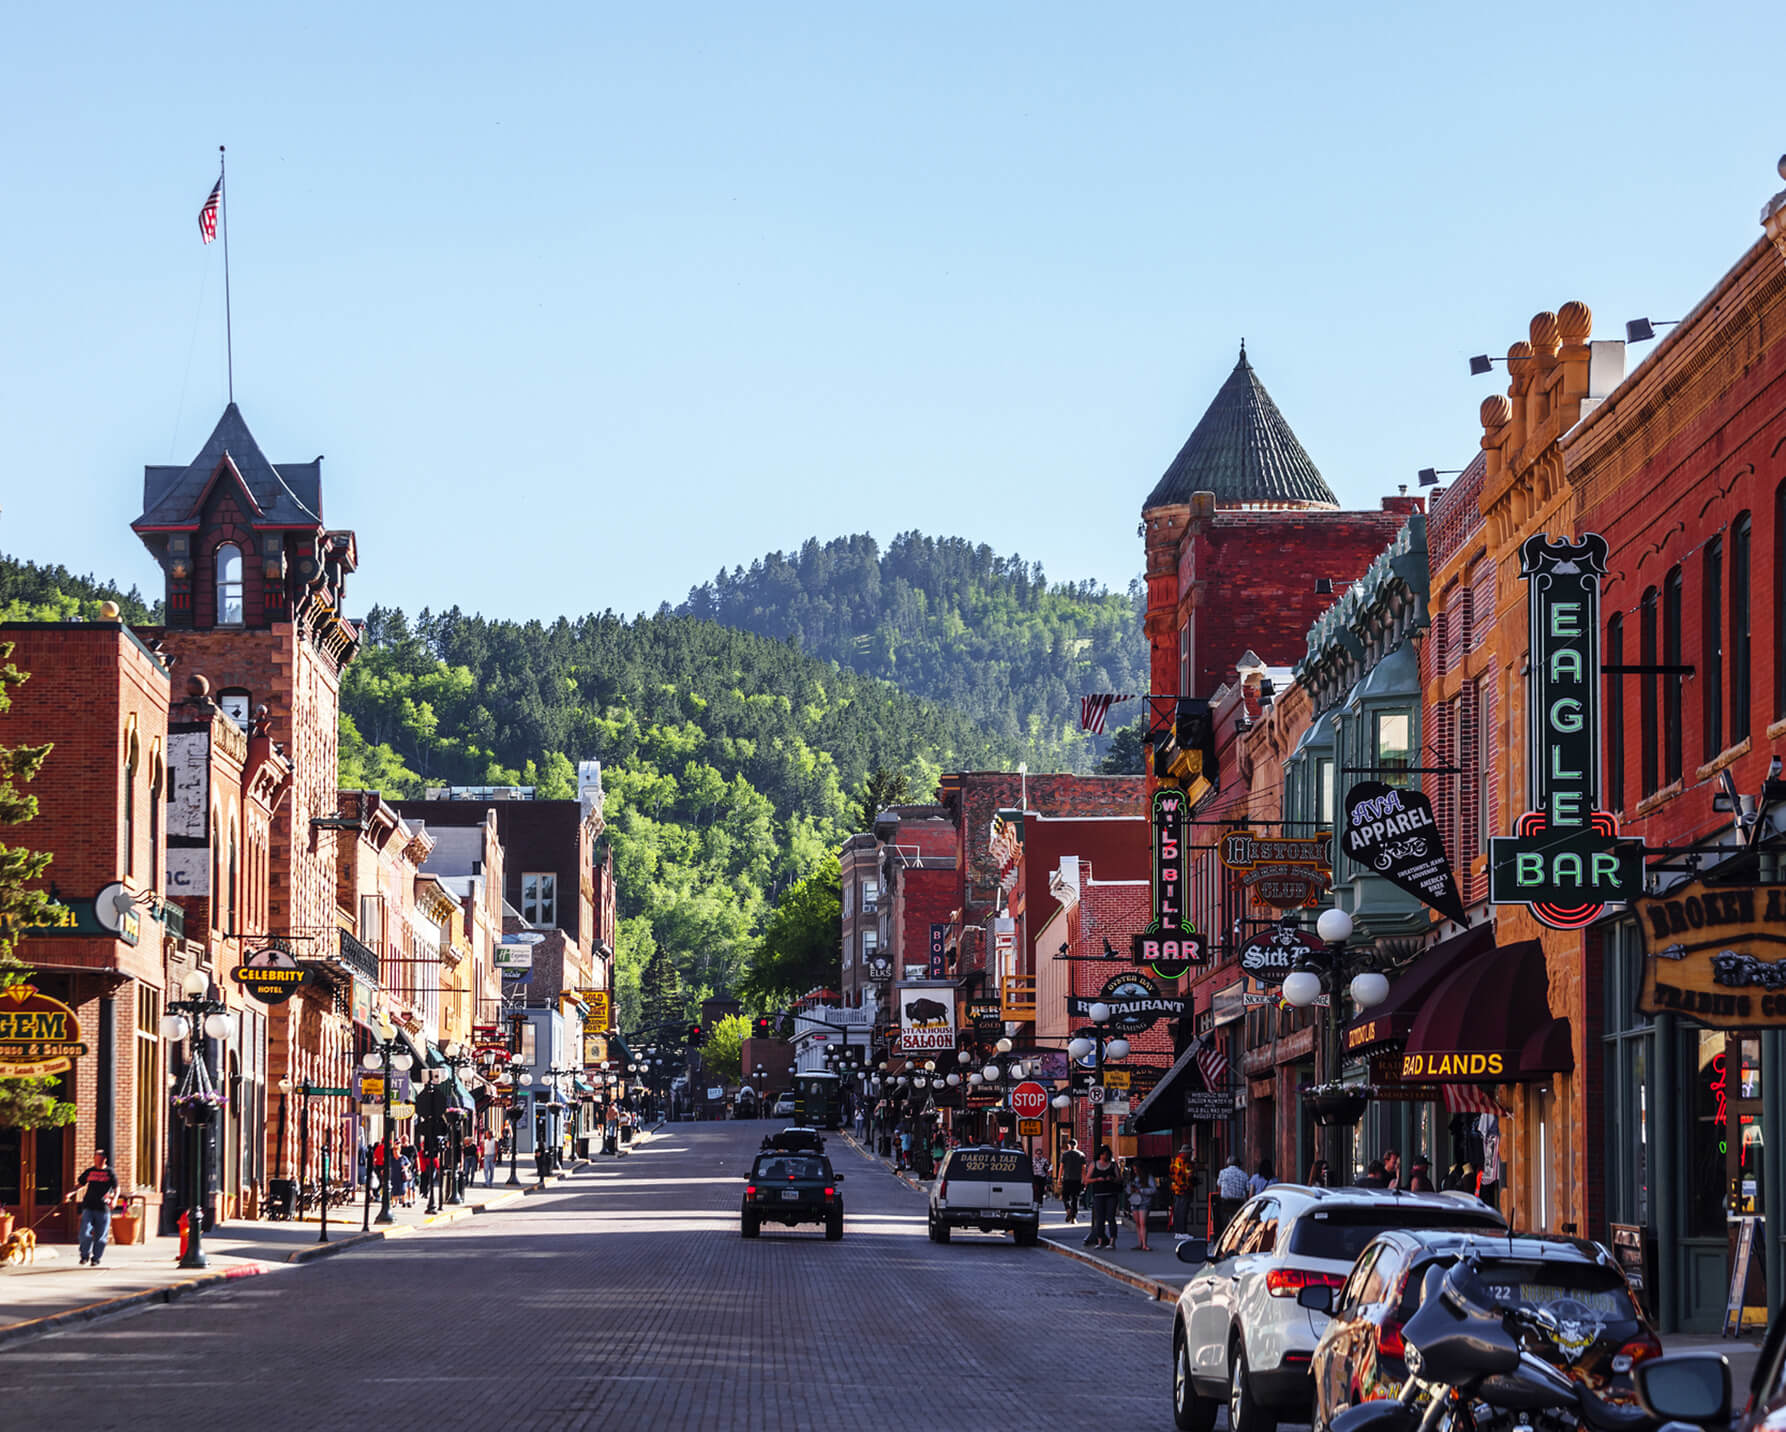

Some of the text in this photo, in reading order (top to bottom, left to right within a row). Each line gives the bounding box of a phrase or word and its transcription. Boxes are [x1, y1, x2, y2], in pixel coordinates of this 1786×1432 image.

[1550, 602, 1584, 827] EAGLE
[1351, 790, 1404, 825] AVA
[1350, 806, 1433, 850] APPAREL
[1161, 799, 1179, 930] WILD BILL
[1516, 851, 1623, 888] BAR
[1261, 882, 1306, 898] CLUB
[1647, 889, 1786, 939] BROKEN A
[1143, 940, 1200, 960] BAR
[1242, 945, 1290, 970] Sick
[238, 967, 305, 982] CELEBRITY
[869, 969, 892, 977] ELKS
[258, 985, 284, 994] HOTEL
[1106, 974, 1138, 991] OYSTER
[1076, 1000, 1185, 1015] RTAURANT
[902, 1027, 953, 1035] STEAKHOUSE
[43, 1044, 83, 1055] Saloon
[903, 1034, 953, 1049] SALOON
[1014, 1093, 1046, 1108] STOP
